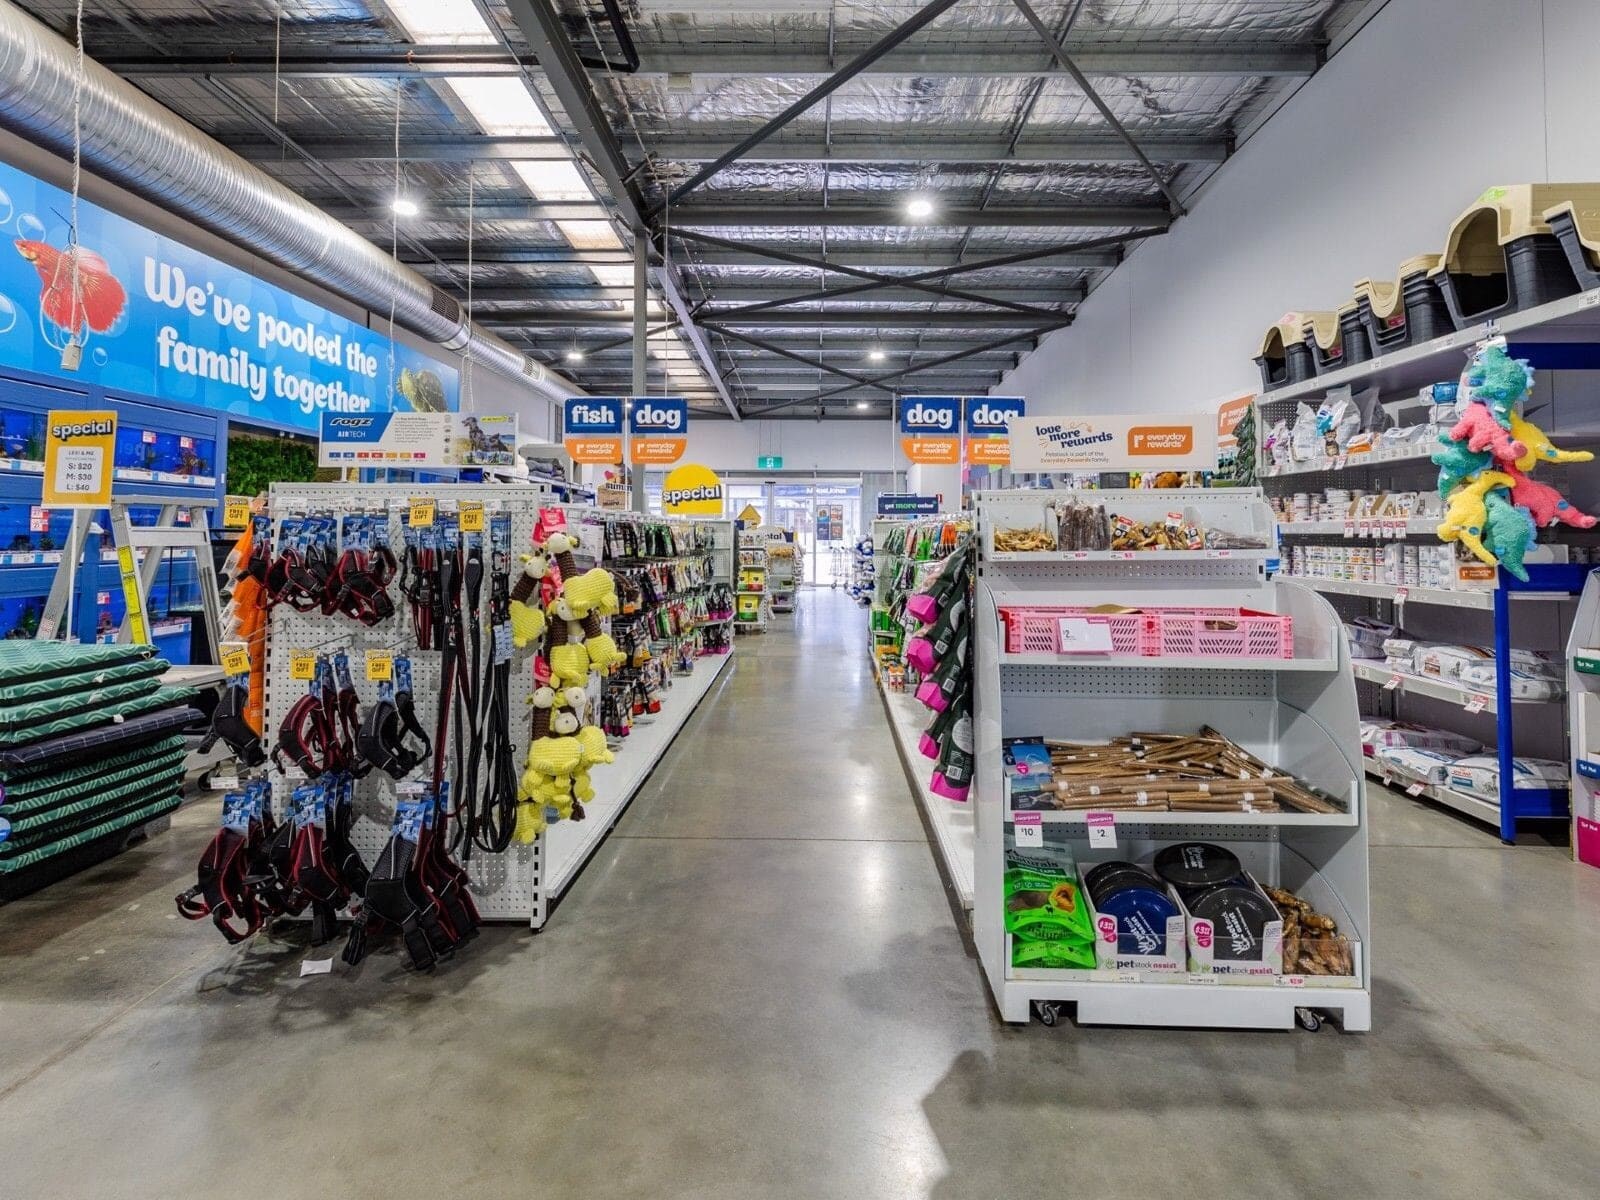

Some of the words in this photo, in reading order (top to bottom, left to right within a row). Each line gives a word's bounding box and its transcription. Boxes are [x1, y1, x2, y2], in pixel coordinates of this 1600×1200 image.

[144, 256, 250, 331] We've
[257, 310, 342, 365] pooled
[345, 342, 377, 378] the
[157, 326, 267, 401] family
[273, 367, 370, 414] together
[572, 405, 616, 424] fish
[635, 404, 681, 430] dog
[906, 403, 953, 429] dog
[972, 404, 1019, 429] dog
[330, 417, 374, 428] rogz
[1036, 424, 1061, 436] love
[52, 419, 112, 442] special
[1049, 429, 1080, 442] more
[1147, 433, 1186, 443] everyday
[1060, 431, 1113, 449] rewards
[1147, 440, 1182, 448] rewards
[77, 462, 92, 470] $20
[77, 473, 92, 481] $30
[662, 485, 721, 506] special
[1021, 828, 1034, 836] $10
[1097, 829, 1106, 838] $2
